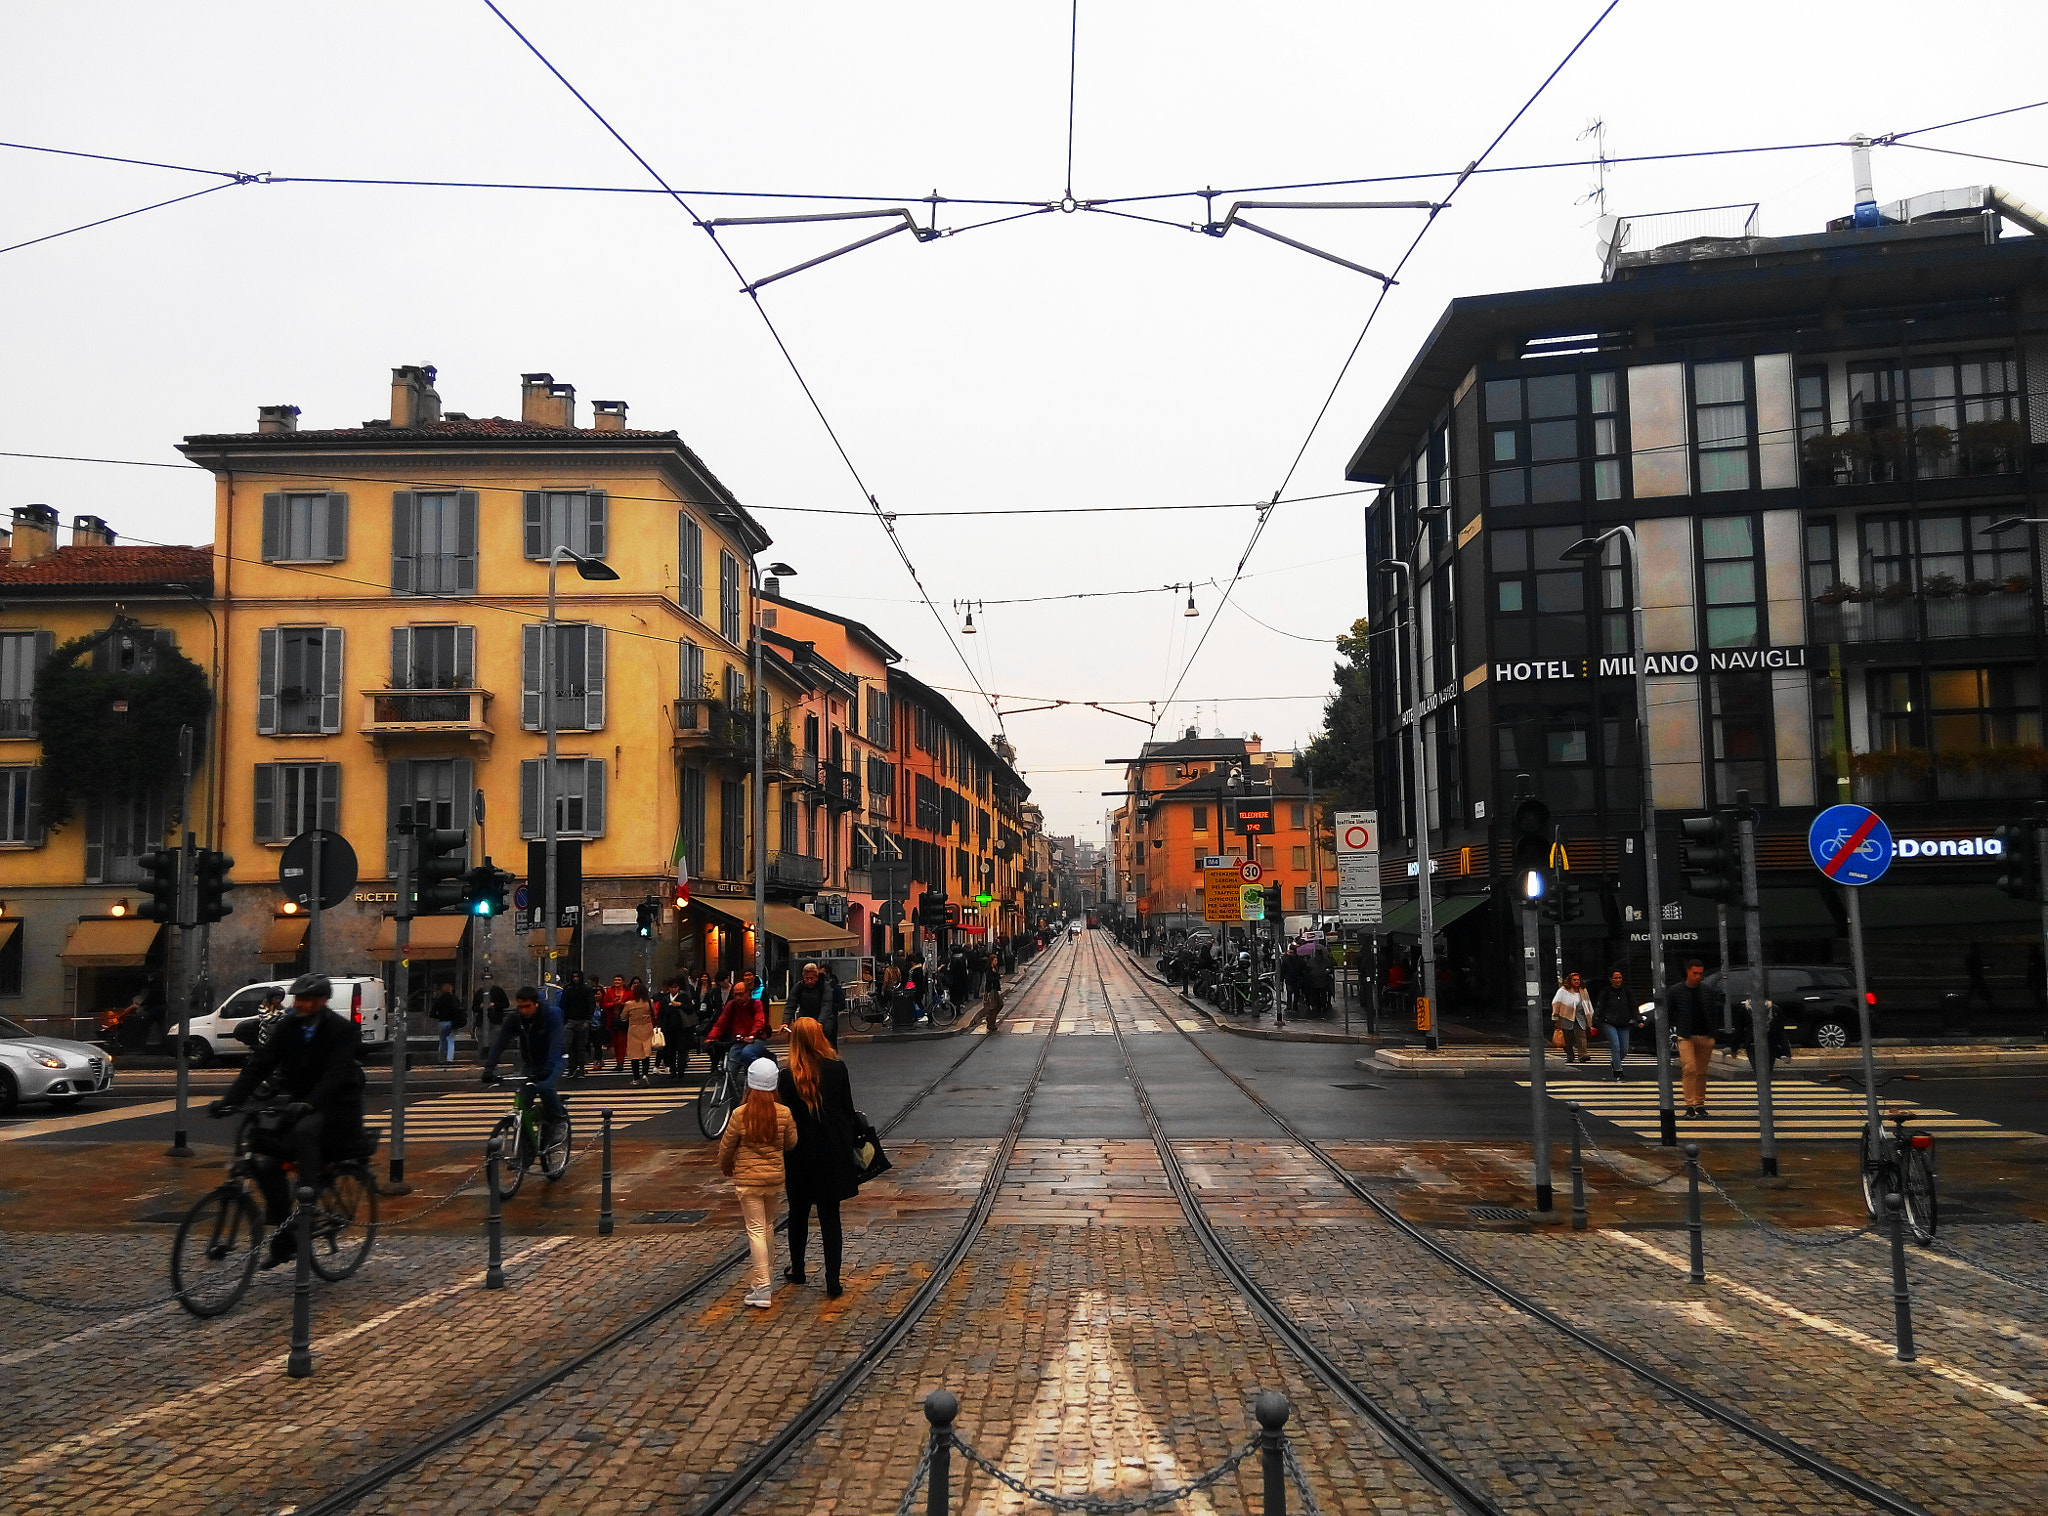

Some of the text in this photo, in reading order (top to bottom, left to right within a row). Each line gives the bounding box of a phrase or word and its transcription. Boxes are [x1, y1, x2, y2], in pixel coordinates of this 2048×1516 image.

[1496, 648, 1806, 681] HOTEL MILANO NAVIGLI
[1401, 707, 1415, 727] HOTE
[1244, 866, 1258, 878] 30
[355, 892, 399, 902] RICETT
[1630, 932, 1699, 942] Mcnald's
